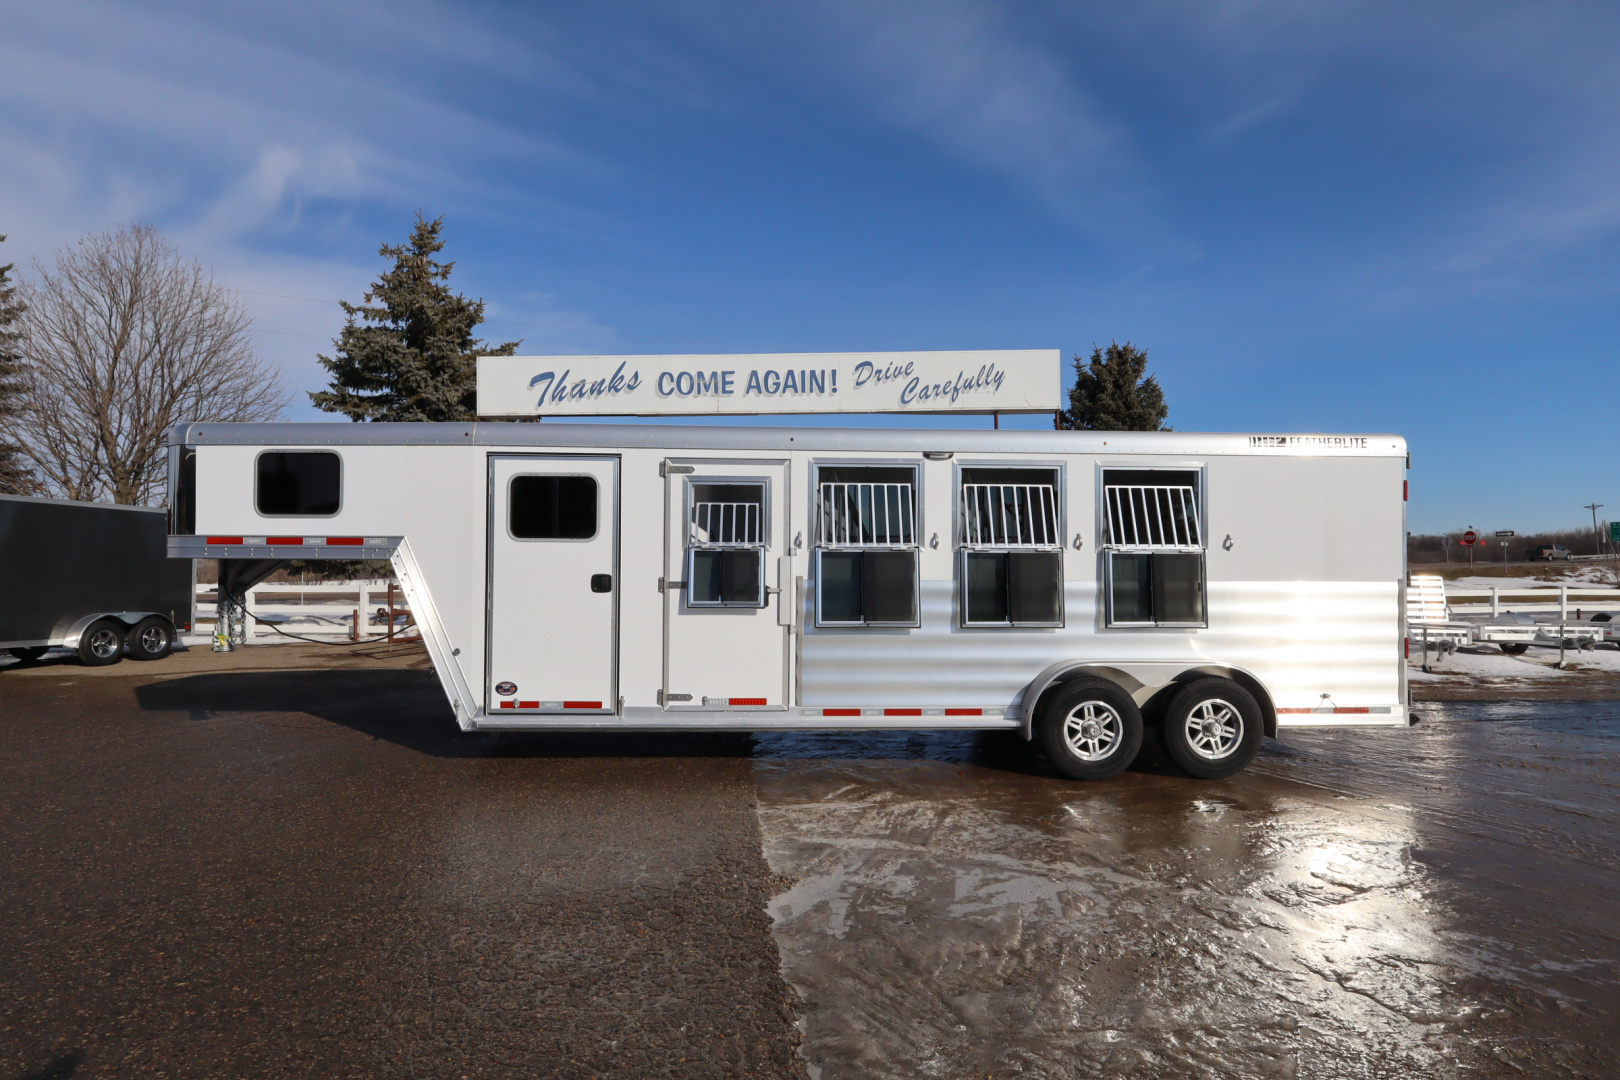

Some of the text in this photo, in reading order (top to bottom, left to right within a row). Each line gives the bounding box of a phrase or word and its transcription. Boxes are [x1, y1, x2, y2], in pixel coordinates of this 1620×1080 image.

[529, 361, 838, 408] Thanks COME AGAIN!
[854, 361, 915, 387] Drive
[900, 363, 1006, 405] Carefully
[1289, 437, 1368, 448] FEATHERLITE
